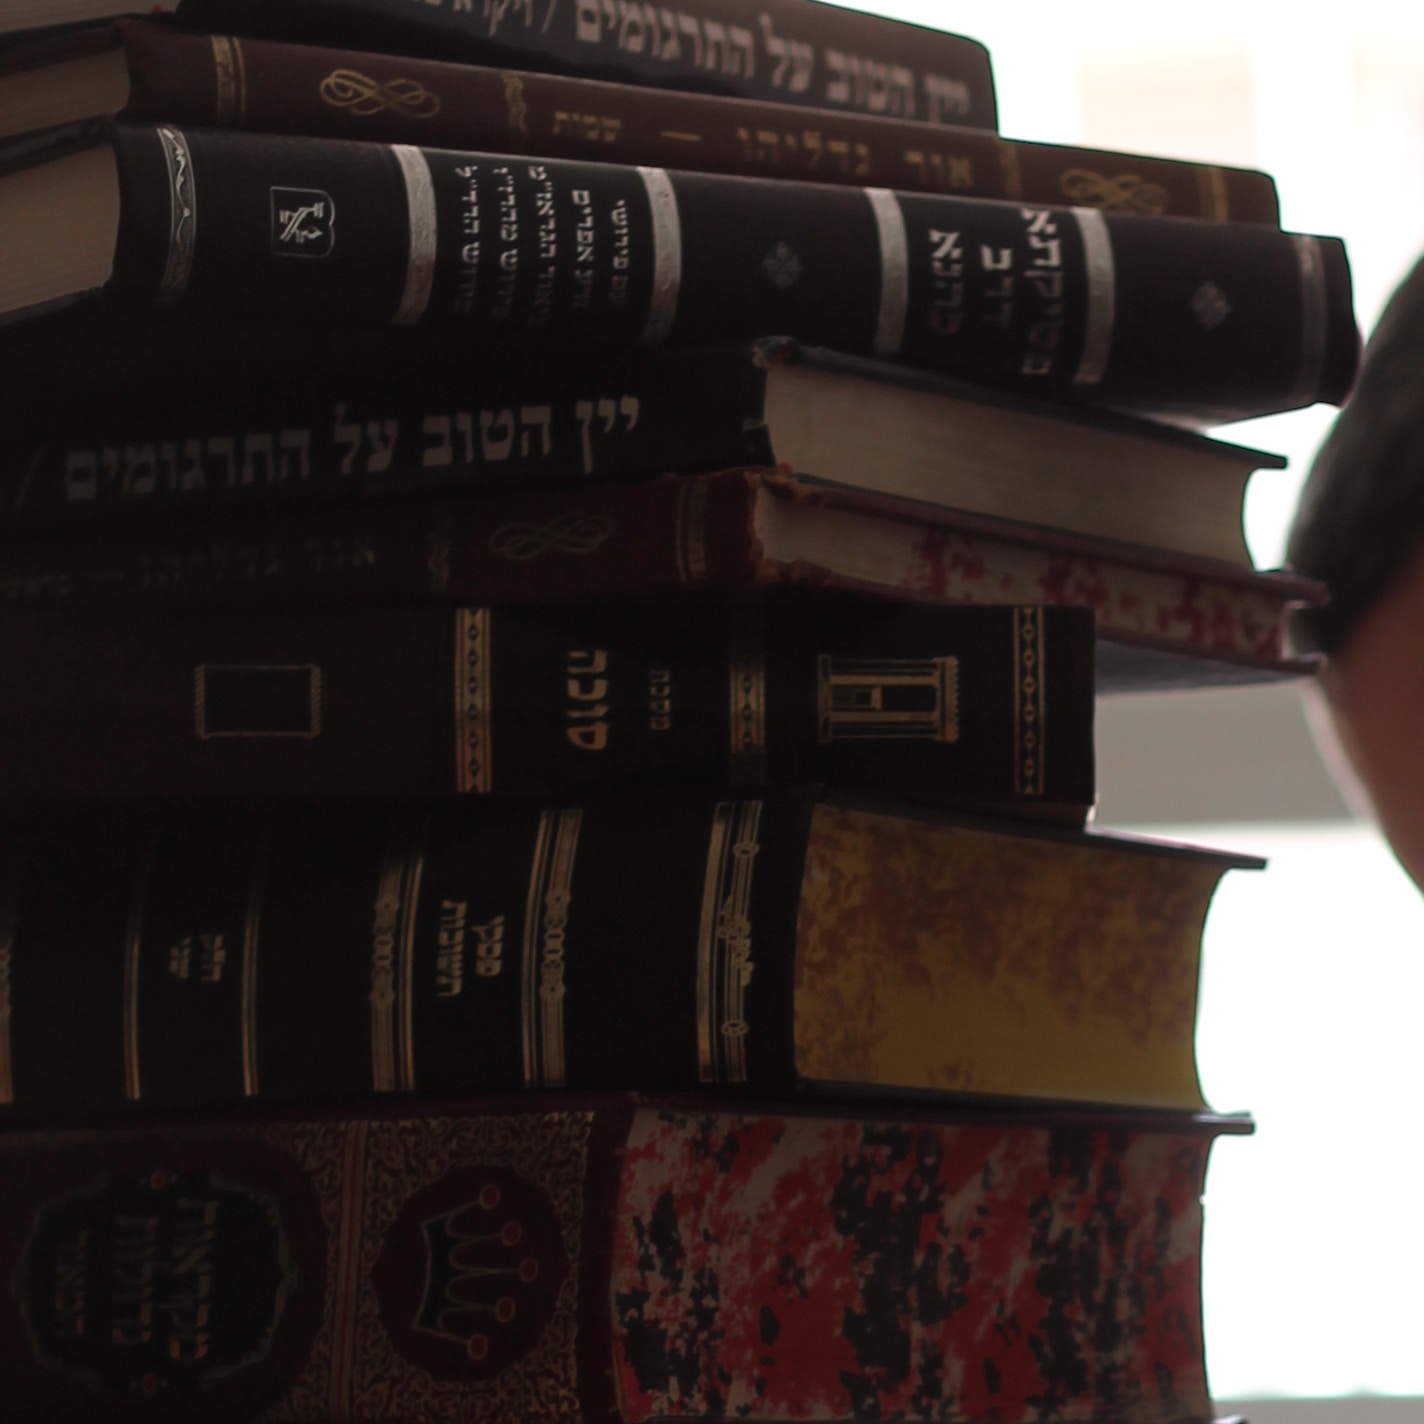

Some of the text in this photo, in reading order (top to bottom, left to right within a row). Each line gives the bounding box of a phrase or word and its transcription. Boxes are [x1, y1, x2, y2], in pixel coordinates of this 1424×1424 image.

[574, 0, 755, 79] התרגומים
[760, 13, 813, 94] על
[825, 46, 915, 118] הטוב
[923, 74, 970, 123] יין
[736, 126, 871, 176] גדליהו
[904, 149, 974, 190] אור
[455, 241, 480, 312] פירוש
[491, 248, 518, 320] פירוש
[571, 189, 595, 309] זרע אפרים
[609, 199, 630, 305] עם פירושי
[928, 229, 964, 336] כהנא
[978, 244, 1015, 328] דרב
[528, 266, 556, 326] ביאור
[1020, 208, 1065, 377] פסיקתא
[63, 394, 640, 503] יין הטוב על התרגומים
[565, 649, 609, 751] סוכה
[649, 669, 671, 731] מסכת
[437, 899, 468, 997] תשובות
[472, 915, 505, 976] פסקי
[112, 1215, 174, 1345] גדולות
[159, 1199, 219, 1364] מקראות
